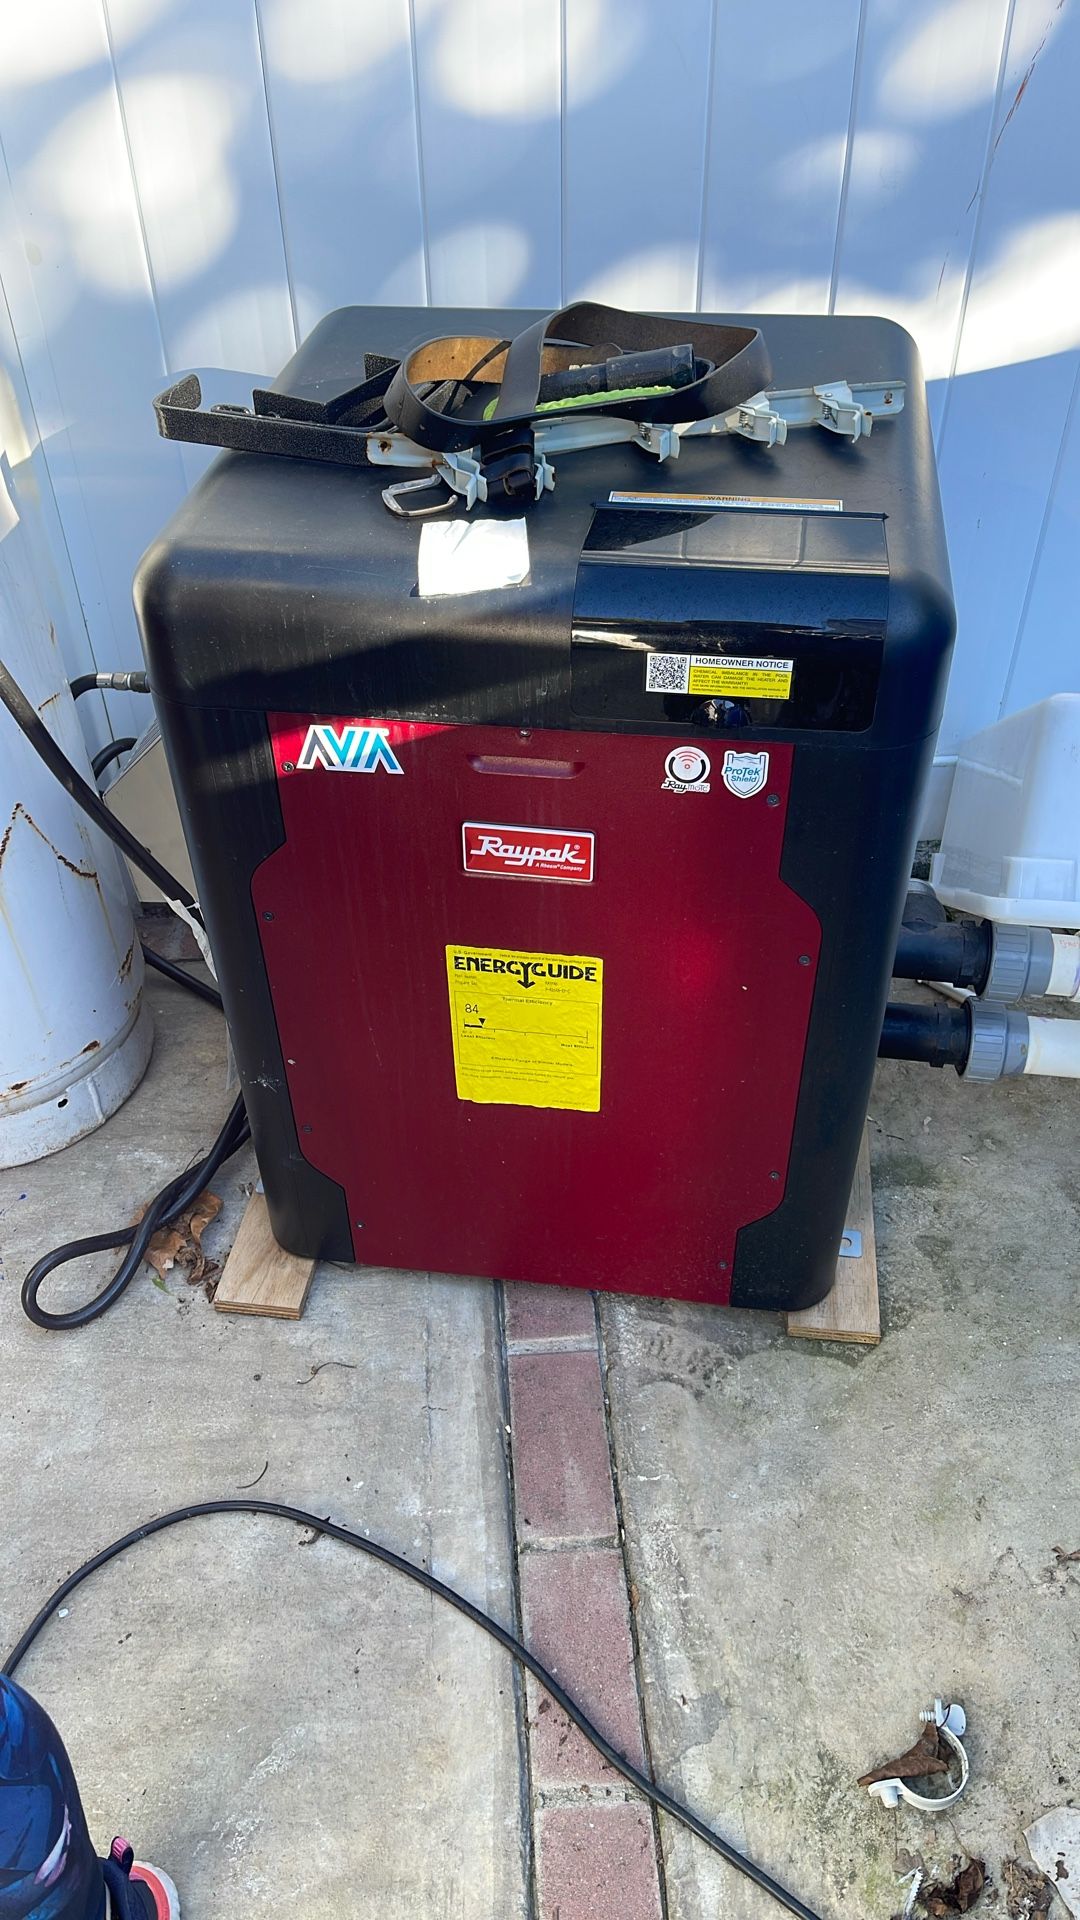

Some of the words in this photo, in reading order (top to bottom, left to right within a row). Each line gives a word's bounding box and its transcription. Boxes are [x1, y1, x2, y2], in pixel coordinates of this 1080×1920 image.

[695, 657, 756, 667] HOMEOWNER
[756, 658, 789, 669] NOTICE
[724, 766, 761, 777] ProTek
[731, 775, 757, 783] Shield
[560, 864, 583, 872] Company
[454, 956, 597, 988] ENERGYGUIDE
[464, 1003, 479, 1014] 84
